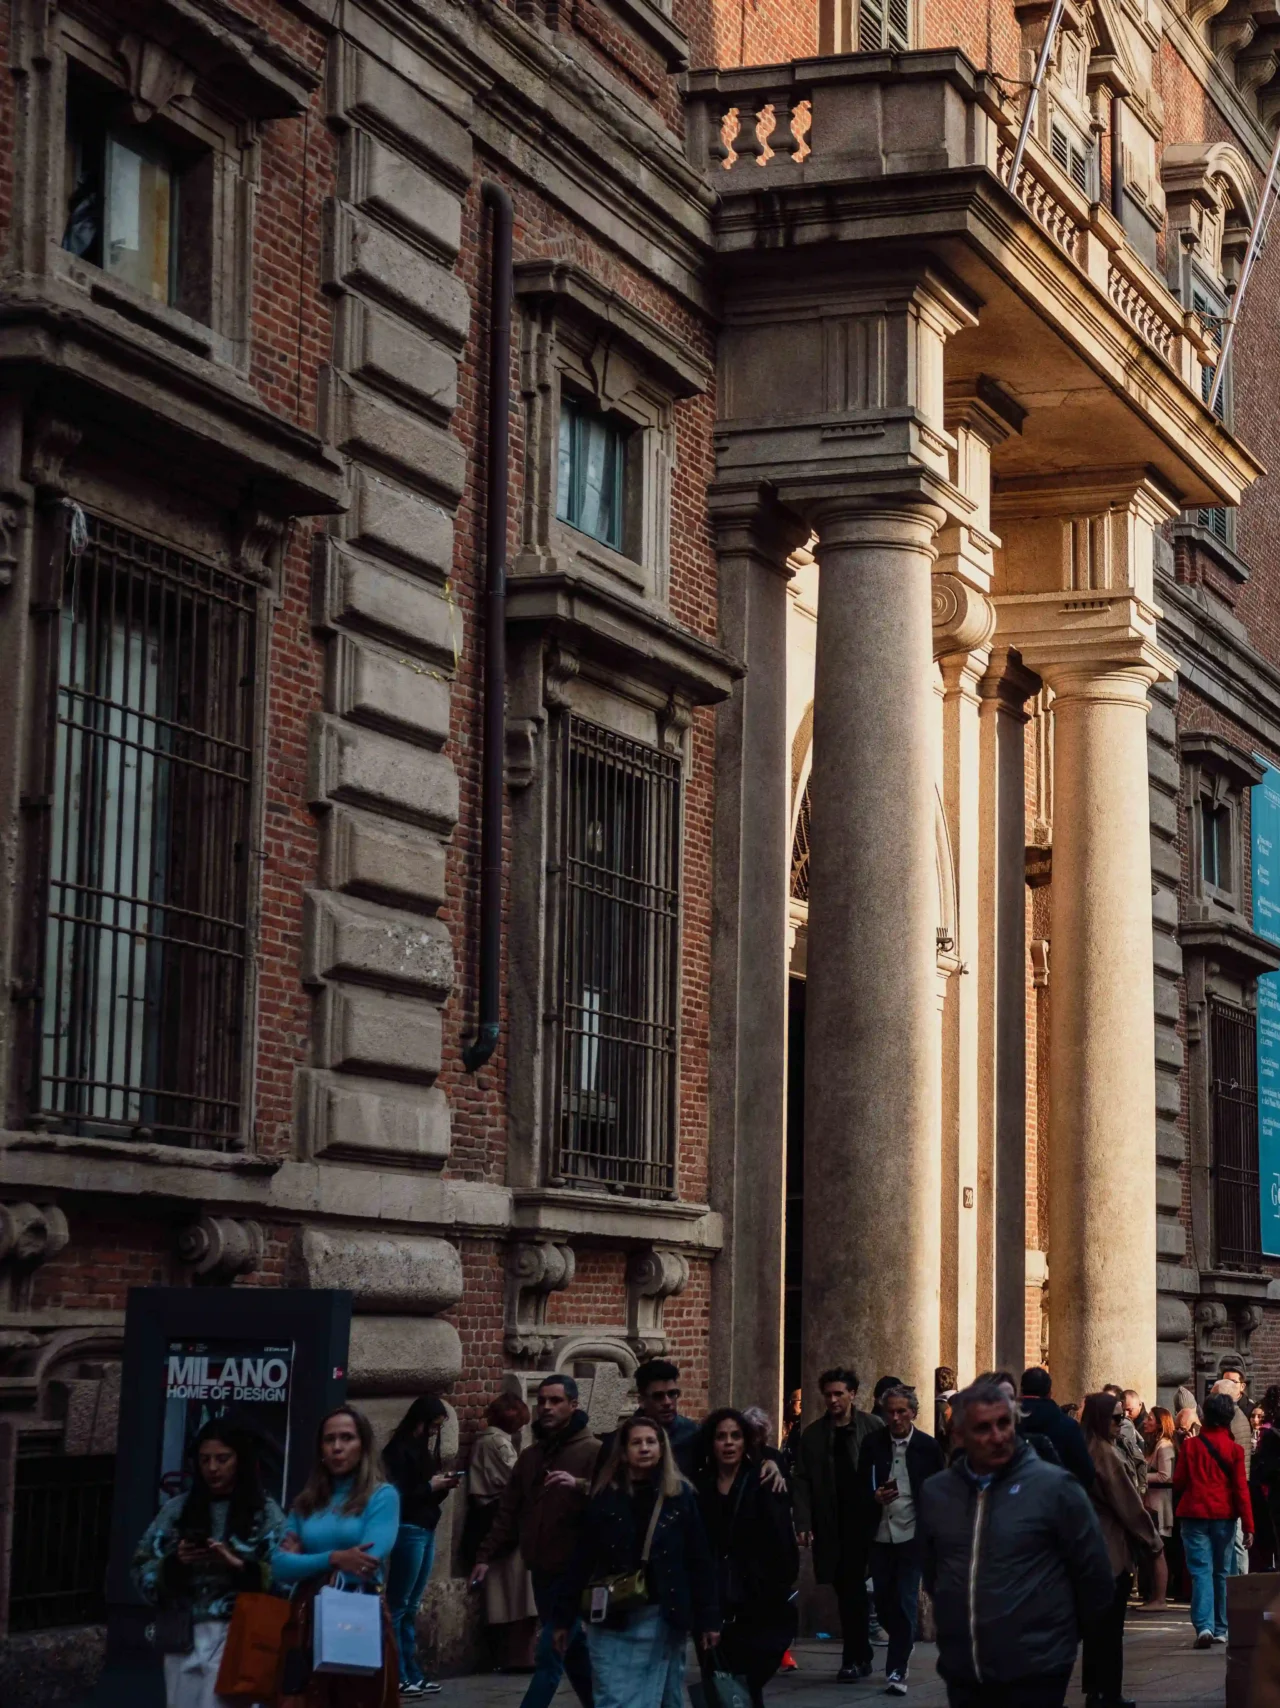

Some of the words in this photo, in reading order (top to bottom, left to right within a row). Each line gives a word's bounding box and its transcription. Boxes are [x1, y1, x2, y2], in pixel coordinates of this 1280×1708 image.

[167, 1356, 288, 1388] MILANO
[166, 1385, 208, 1399] HOME
[210, 1386, 231, 1400] OF
[233, 1387, 286, 1402] DESIGN
